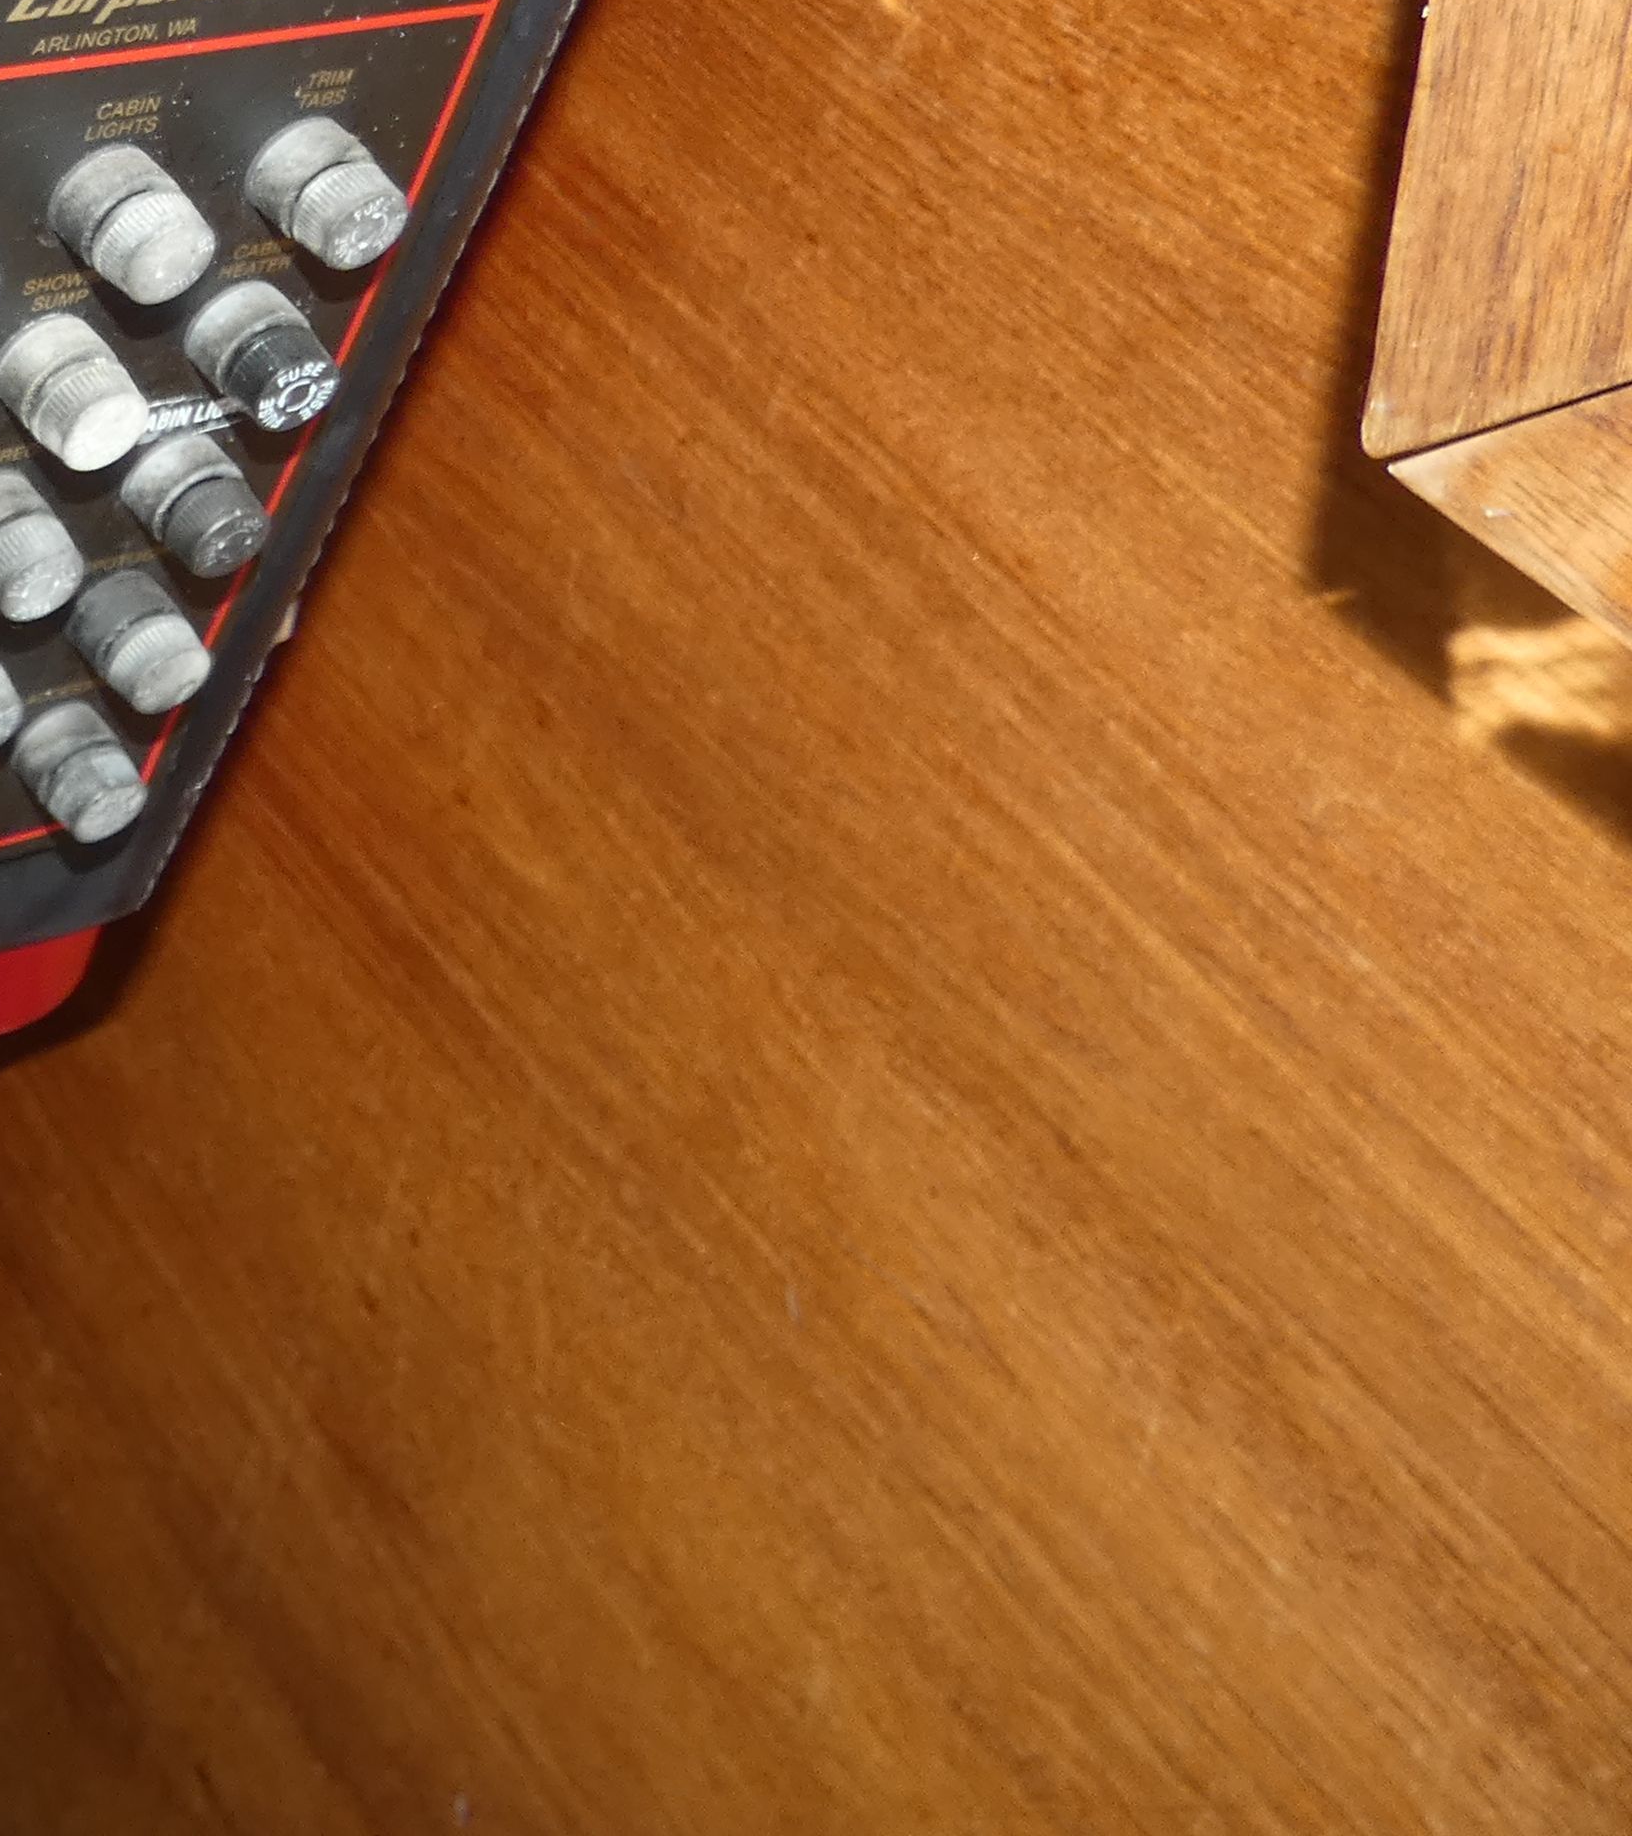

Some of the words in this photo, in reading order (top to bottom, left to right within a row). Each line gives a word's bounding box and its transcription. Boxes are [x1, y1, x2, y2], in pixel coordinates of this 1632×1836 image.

[32, 21, 159, 56] ARLINGTON,
[167, 17, 200, 38] WA
[308, 68, 355, 89] TRIM
[96, 96, 162, 121] CABIN
[298, 89, 346, 109] TABS
[84, 115, 160, 142] LIGHTS
[23, 272, 86, 296] SHOW
[31, 289, 89, 312] SUMP
[277, 362, 326, 388] FUSE
[147, 406, 193, 432] ABIN
